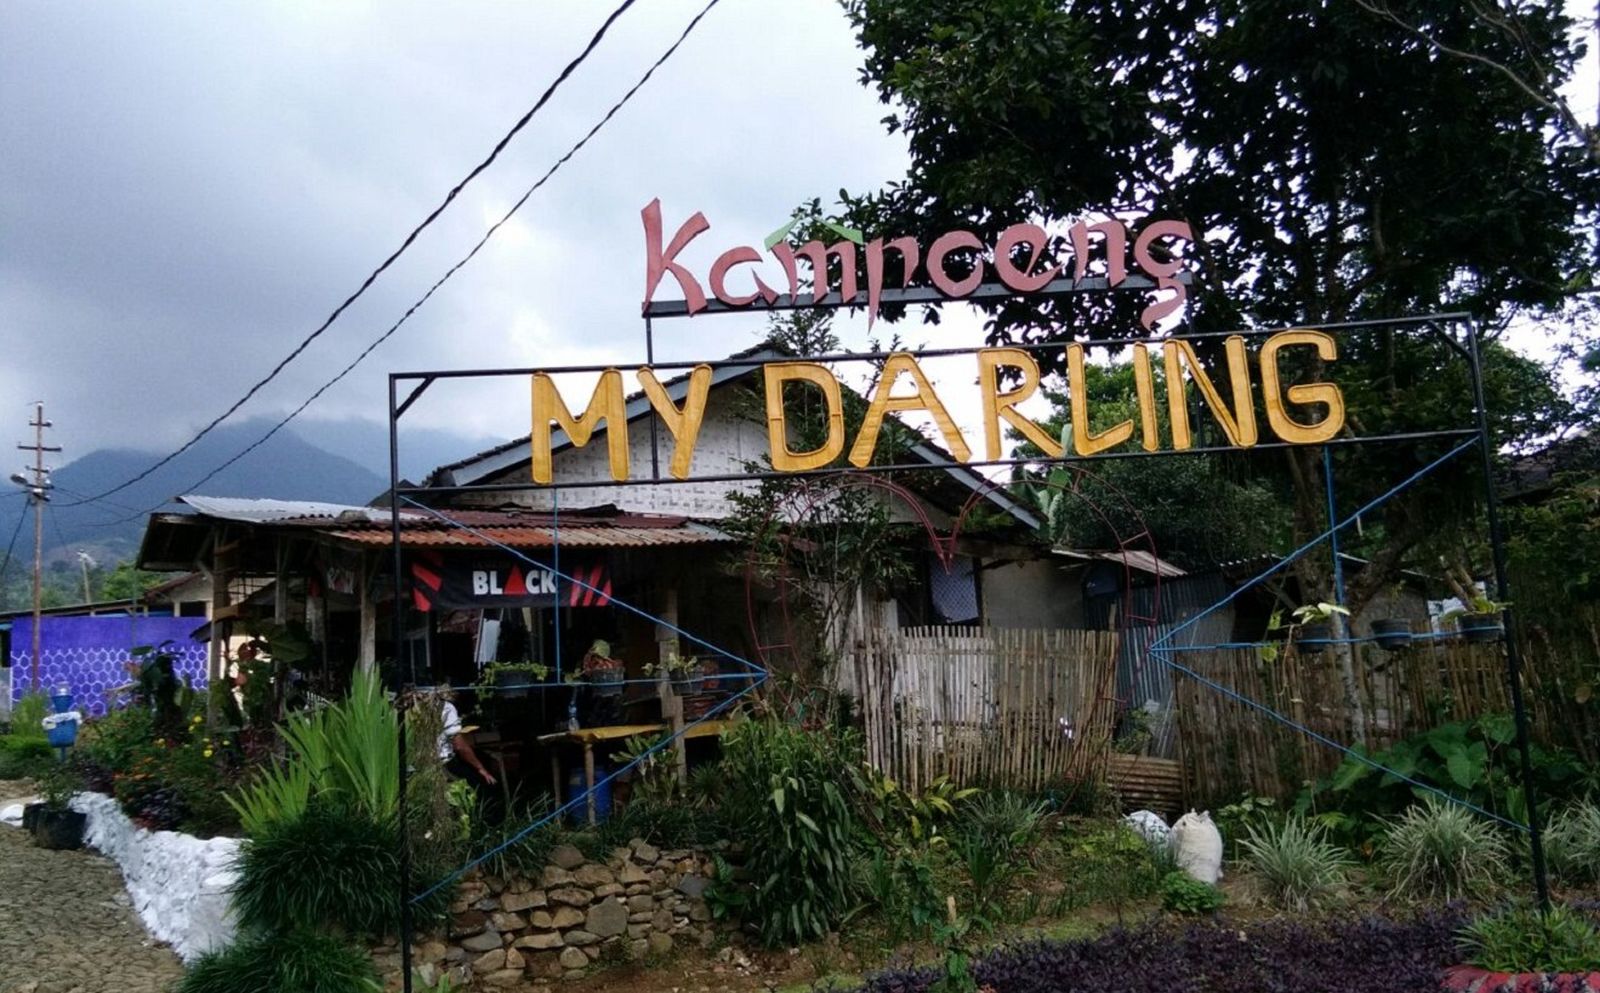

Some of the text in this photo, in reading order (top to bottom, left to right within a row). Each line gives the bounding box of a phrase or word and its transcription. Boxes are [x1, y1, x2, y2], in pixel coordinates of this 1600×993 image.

[531, 329, 1345, 484] MY DARLING
[473, 564, 557, 595] BLACK
